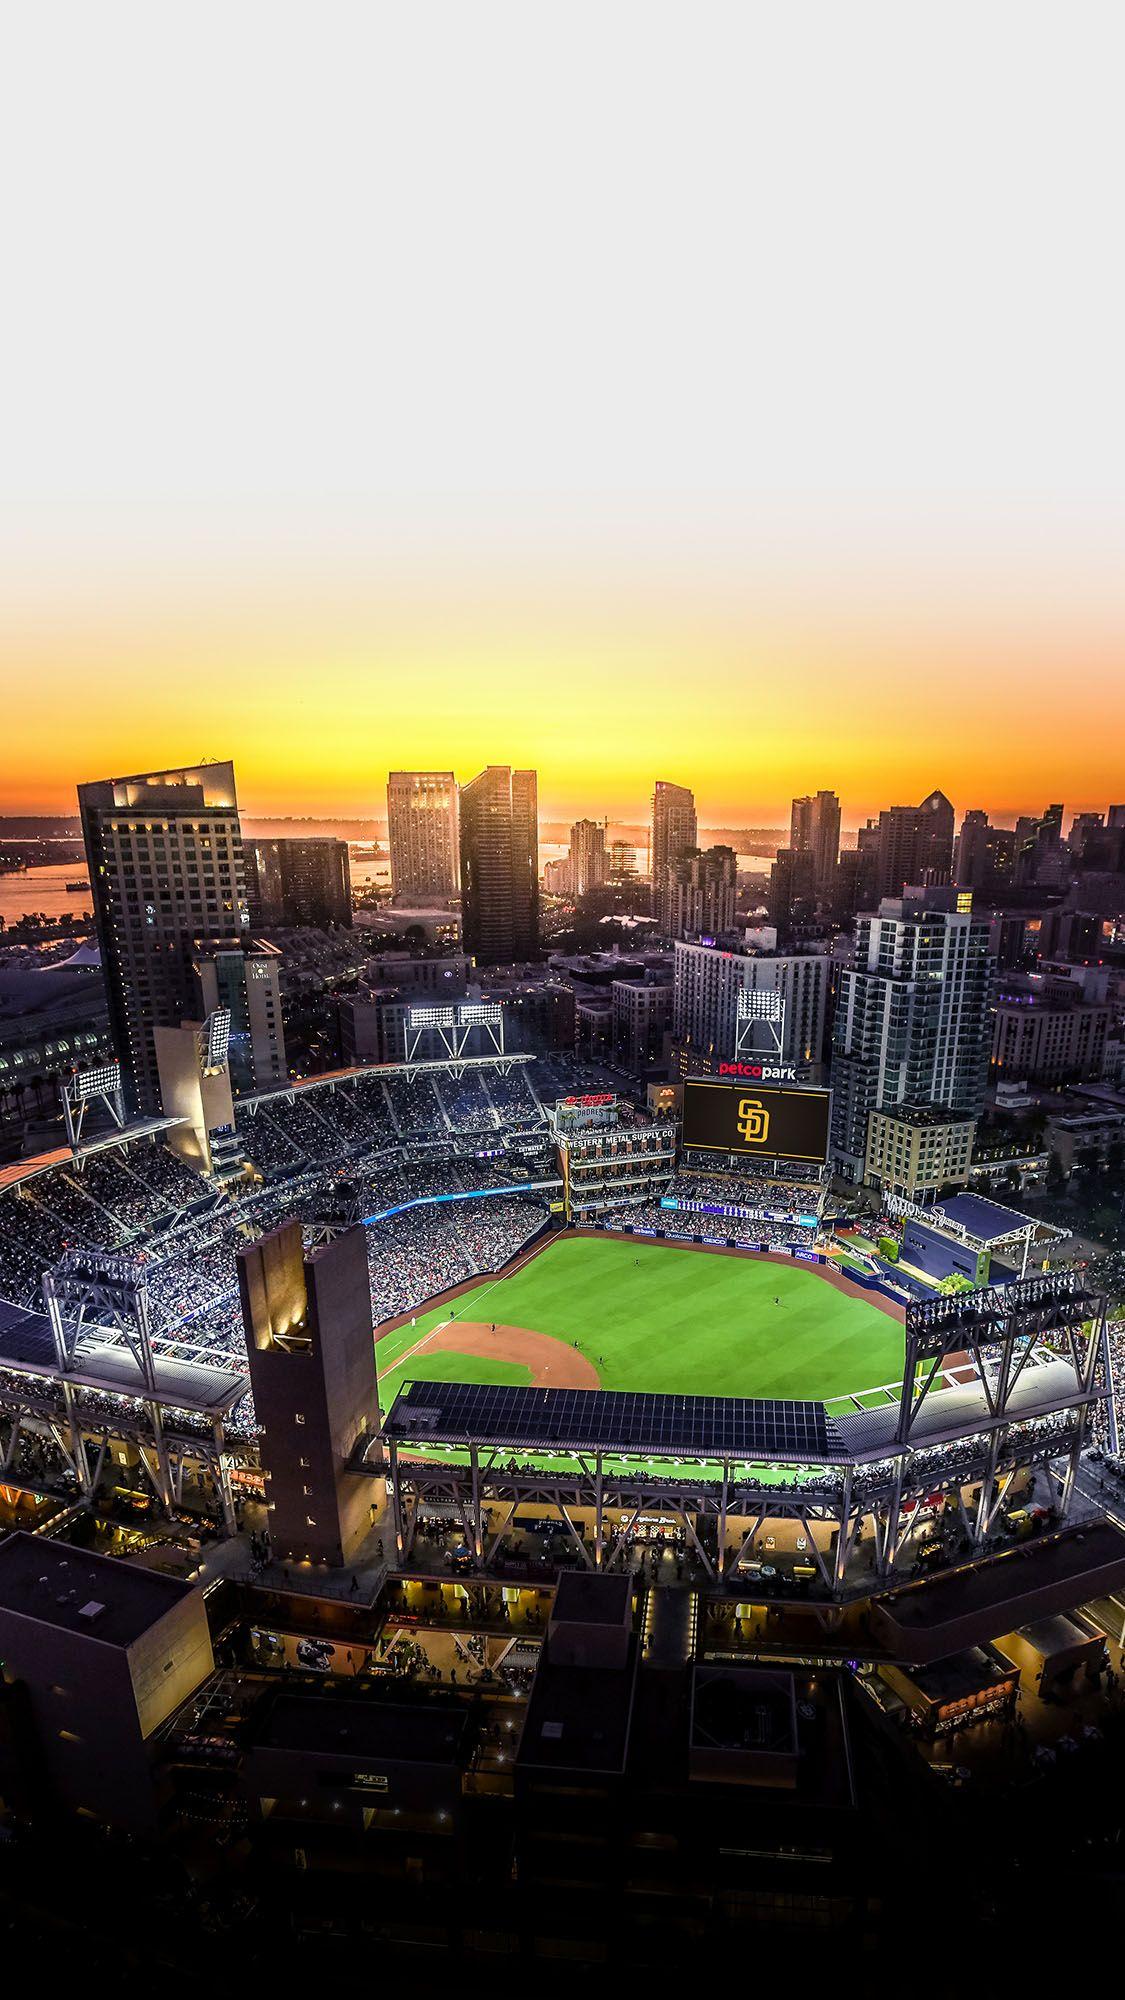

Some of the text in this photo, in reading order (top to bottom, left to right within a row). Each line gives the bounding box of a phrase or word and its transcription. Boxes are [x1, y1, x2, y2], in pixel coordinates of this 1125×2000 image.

[577, 1108, 604, 1118] PADRES
[568, 1138, 603, 1148] WESTERN
[606, 1135, 629, 1144] METAL
[632, 1131, 660, 1141] SUPPLY
[703, 1237, 726, 1245] GEICO
[795, 1251, 812, 1259] ARCO
